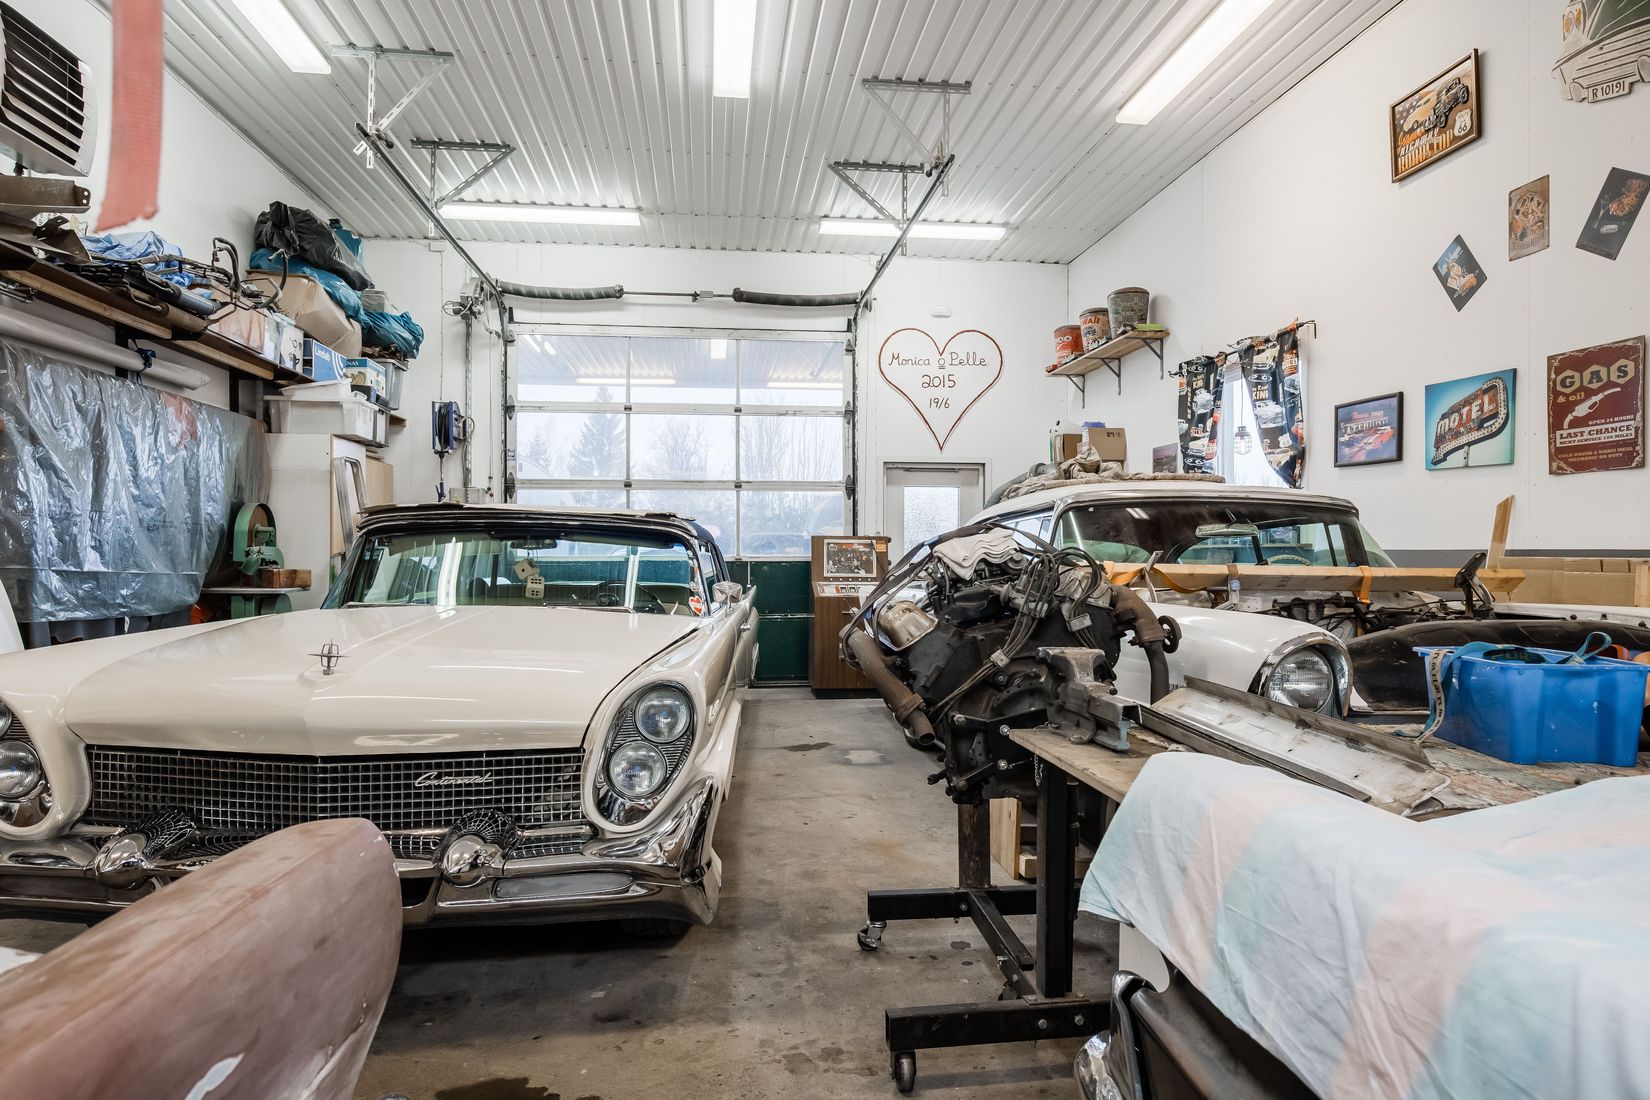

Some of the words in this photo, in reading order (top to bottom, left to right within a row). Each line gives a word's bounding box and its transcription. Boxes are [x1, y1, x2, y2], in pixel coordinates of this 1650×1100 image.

[1592, 88, 1598, 99] R
[1601, 80, 1625, 97] 10191
[1457, 123, 1468, 133] 66
[888, 352, 931, 366] Monica
[921, 374, 956, 388] 2015
[1560, 364, 1629, 389] GAS
[929, 397, 950, 409] 19/6
[1557, 395, 1566, 403] &
[1569, 392, 1585, 401] oil
[1437, 395, 1496, 436] MOTEL
[1560, 431, 1585, 440] LAST
[1588, 424, 1633, 436] CHANCE
[415, 771, 493, 787] Continental
